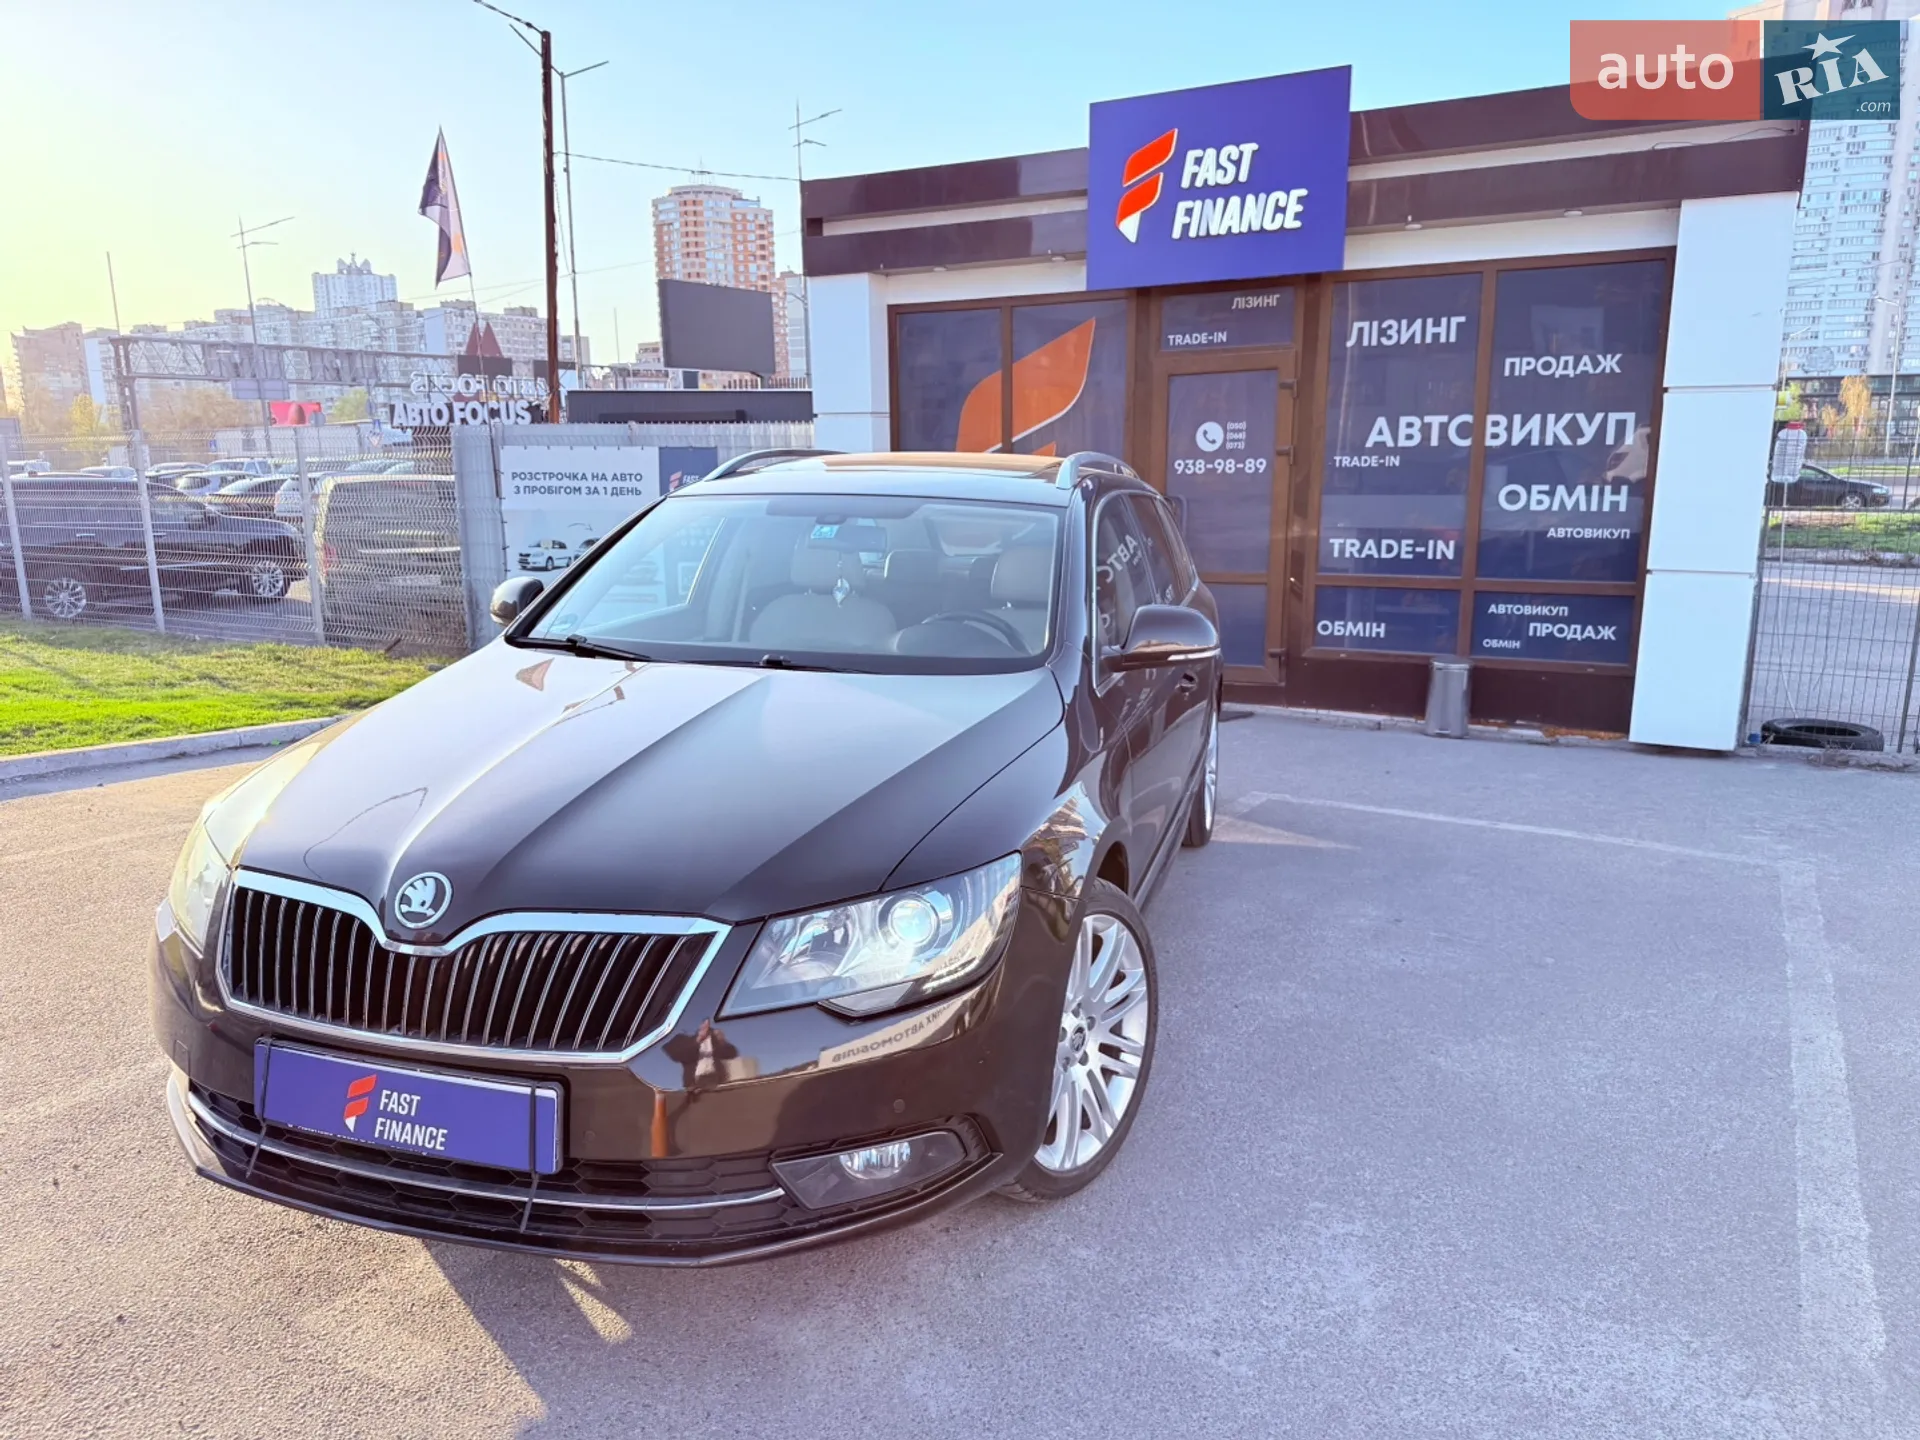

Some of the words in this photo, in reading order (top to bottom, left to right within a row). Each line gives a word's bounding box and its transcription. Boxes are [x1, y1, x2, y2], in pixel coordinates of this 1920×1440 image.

[1180, 142, 1259, 189] FAST
[1171, 188, 1309, 240] FINANCE
[1231, 294, 1281, 310] ЛІЗИНГ
[1167, 331, 1228, 346] TRADE-IN
[1345, 316, 1466, 348] ЛІЗИНГ
[1503, 353, 1623, 379] ПРОДАЖ
[392, 400, 450, 427] АВТО
[453, 399, 533, 426] FOCUS
[1174, 458, 1267, 475] 938-98-89
[1333, 455, 1401, 468] TRADE-IN
[511, 471, 587, 483] РОЗСТРОЧКА
[591, 472, 608, 482] НА
[610, 472, 643, 483] АВТО
[523, 485, 582, 496] ПРОБІГОМ
[586, 486, 600, 496] ЗА
[603, 487, 608, 496] 1
[610, 486, 642, 497] ДЕНЬ
[1497, 484, 1629, 513] ОБМІН
[1546, 526, 1631, 540] АВТОВИКУП
[1329, 538, 1455, 560] TRADE-IN
[1487, 603, 1569, 618] АВТОВИКУП
[1316, 620, 1386, 639] ОБМІН
[1528, 622, 1617, 642] ПРОДАЖ
[1482, 638, 1521, 650] ОБМІН
[379, 1089, 421, 1118] FAST
[374, 1117, 448, 1151] FINANCE
